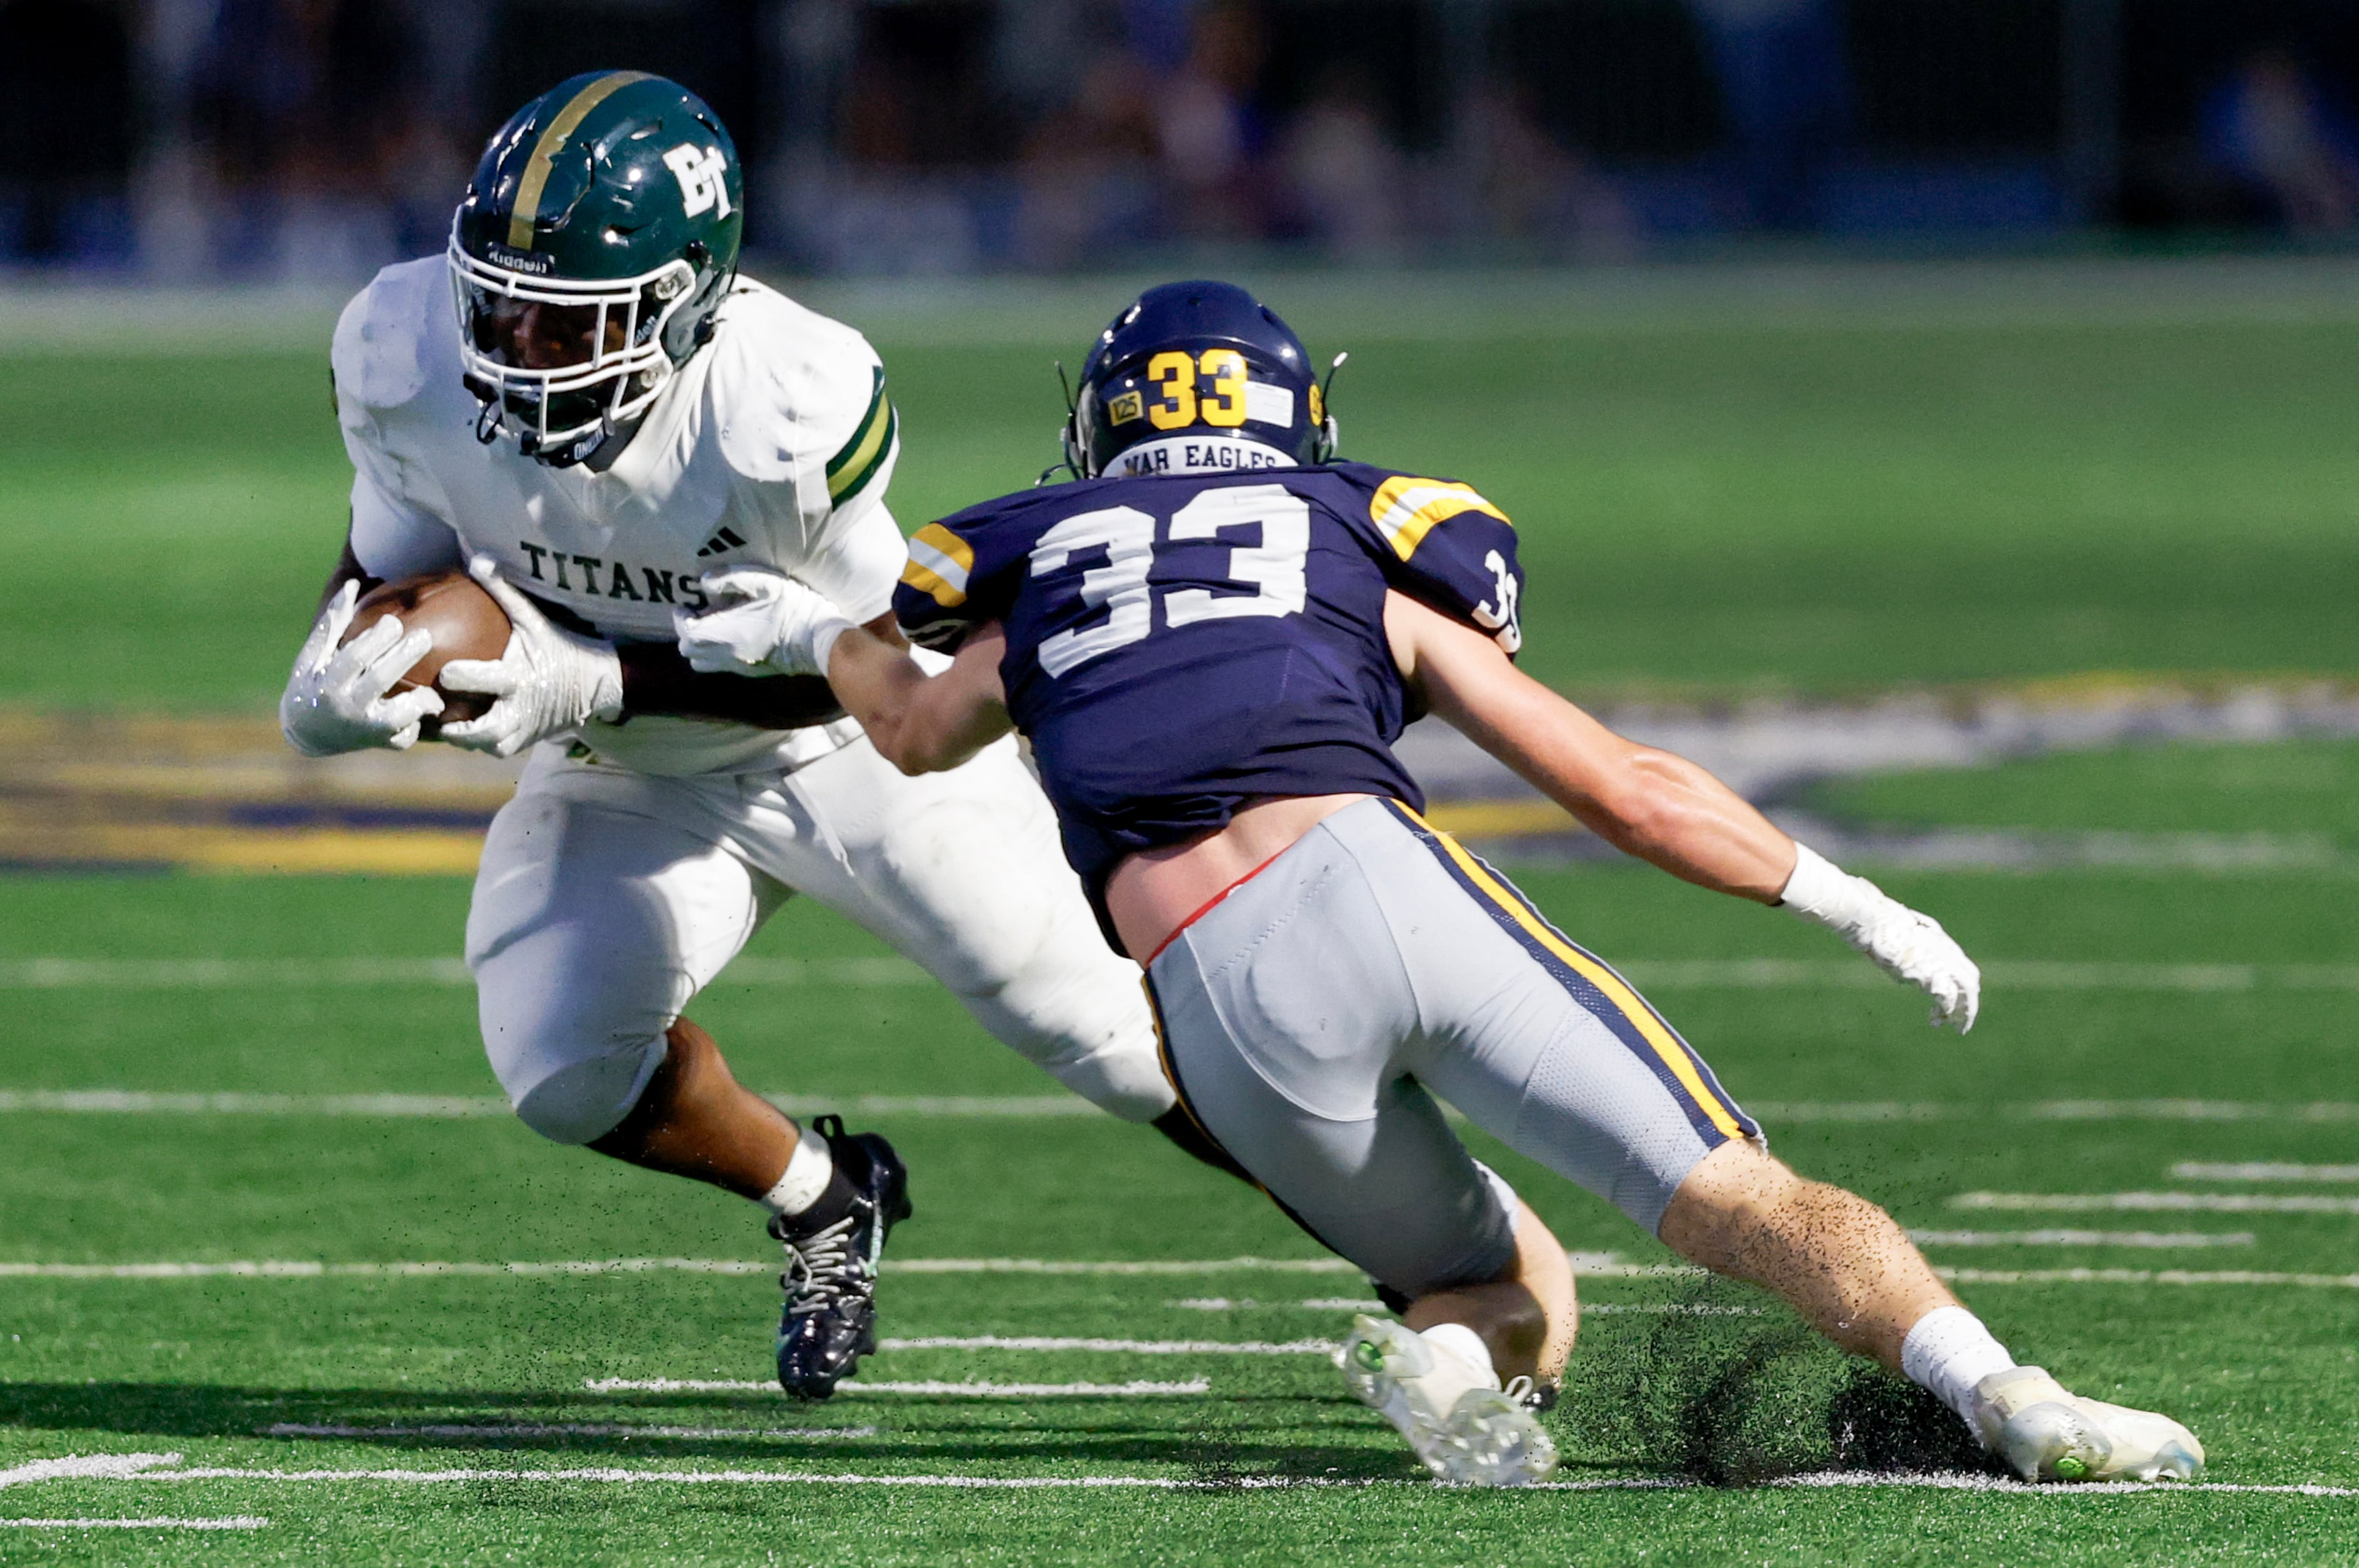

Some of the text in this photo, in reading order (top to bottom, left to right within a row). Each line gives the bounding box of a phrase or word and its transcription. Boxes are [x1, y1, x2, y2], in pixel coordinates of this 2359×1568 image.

[1147, 348, 1248, 430] 33
[520, 540, 709, 610] TITANS
[1029, 483, 1311, 679] 33
